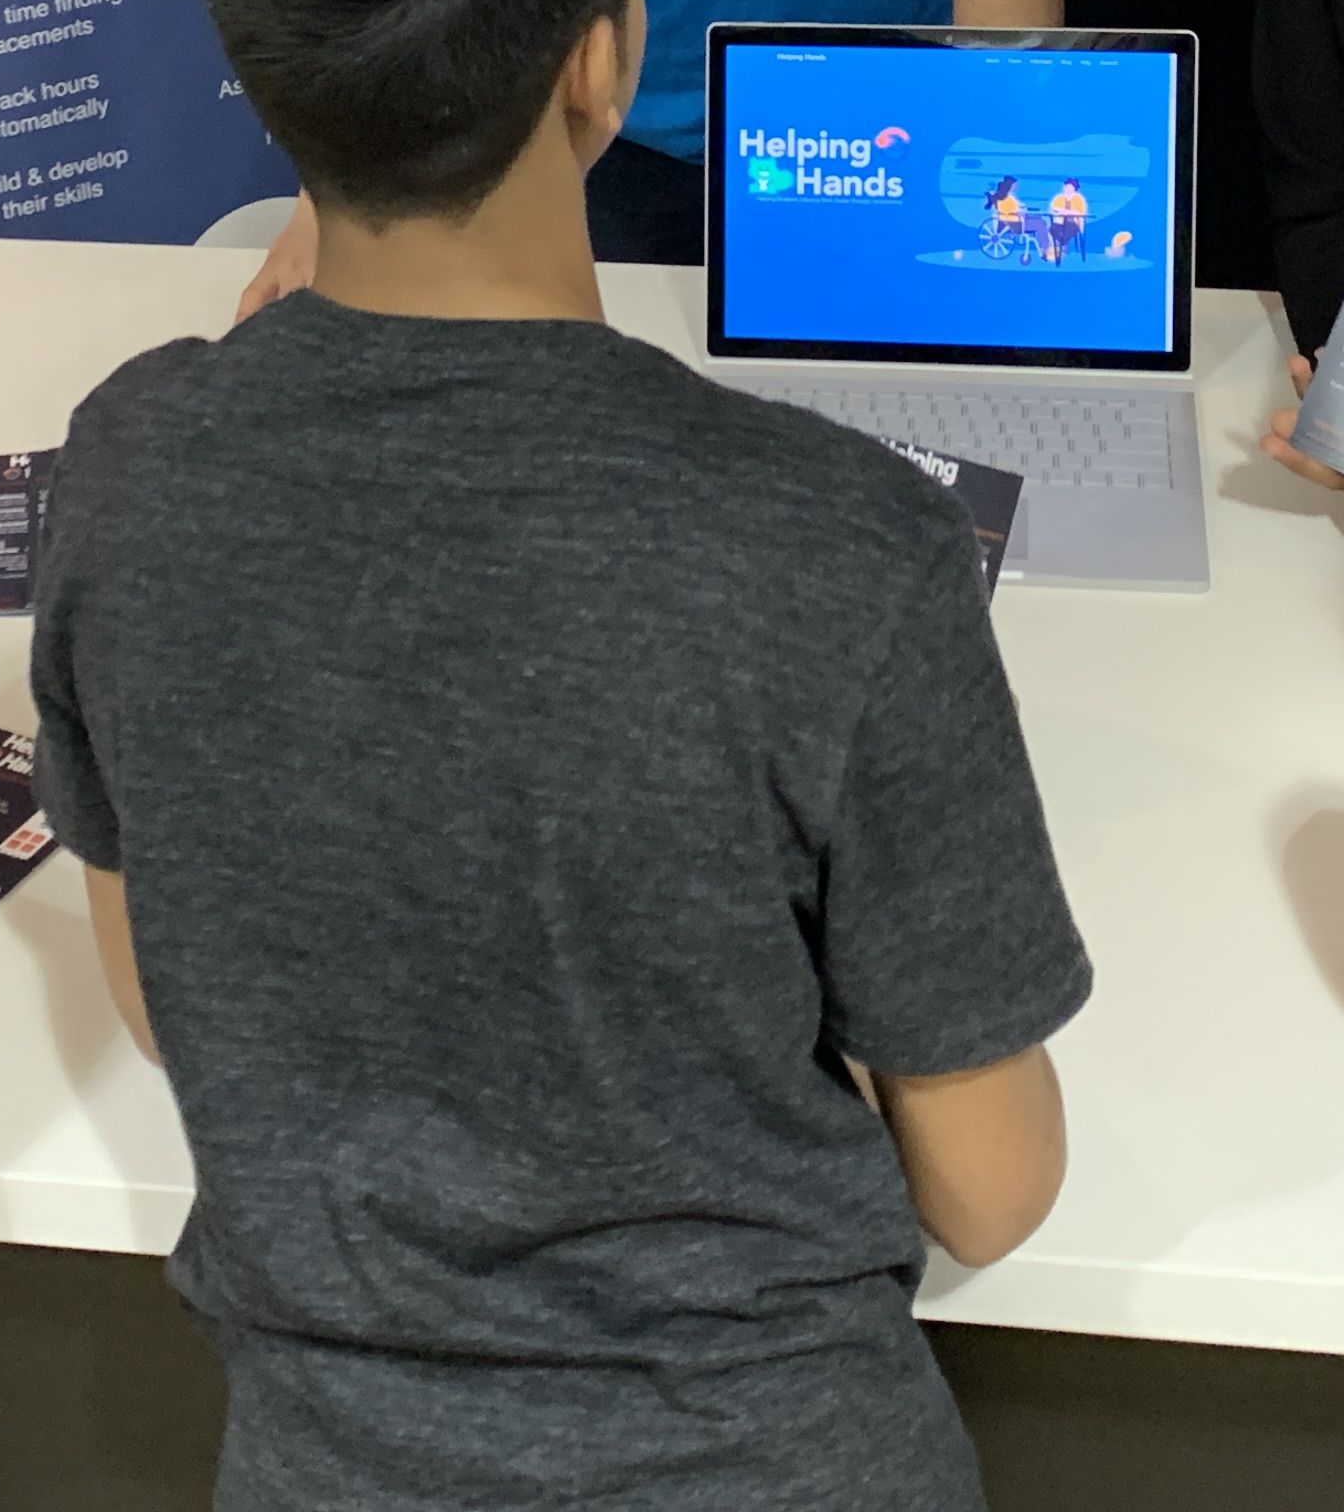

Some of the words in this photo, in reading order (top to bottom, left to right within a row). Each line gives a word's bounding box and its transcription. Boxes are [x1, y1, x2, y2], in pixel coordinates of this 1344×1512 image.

[3, 1, 49, 25] time
[40, 73, 100, 101] hours
[738, 127, 872, 167] Helping
[27, 167, 44, 186] &
[48, 148, 129, 181] develop
[795, 167, 904, 198] Hands
[1, 195, 48, 220] their
[53, 181, 104, 208] skills
